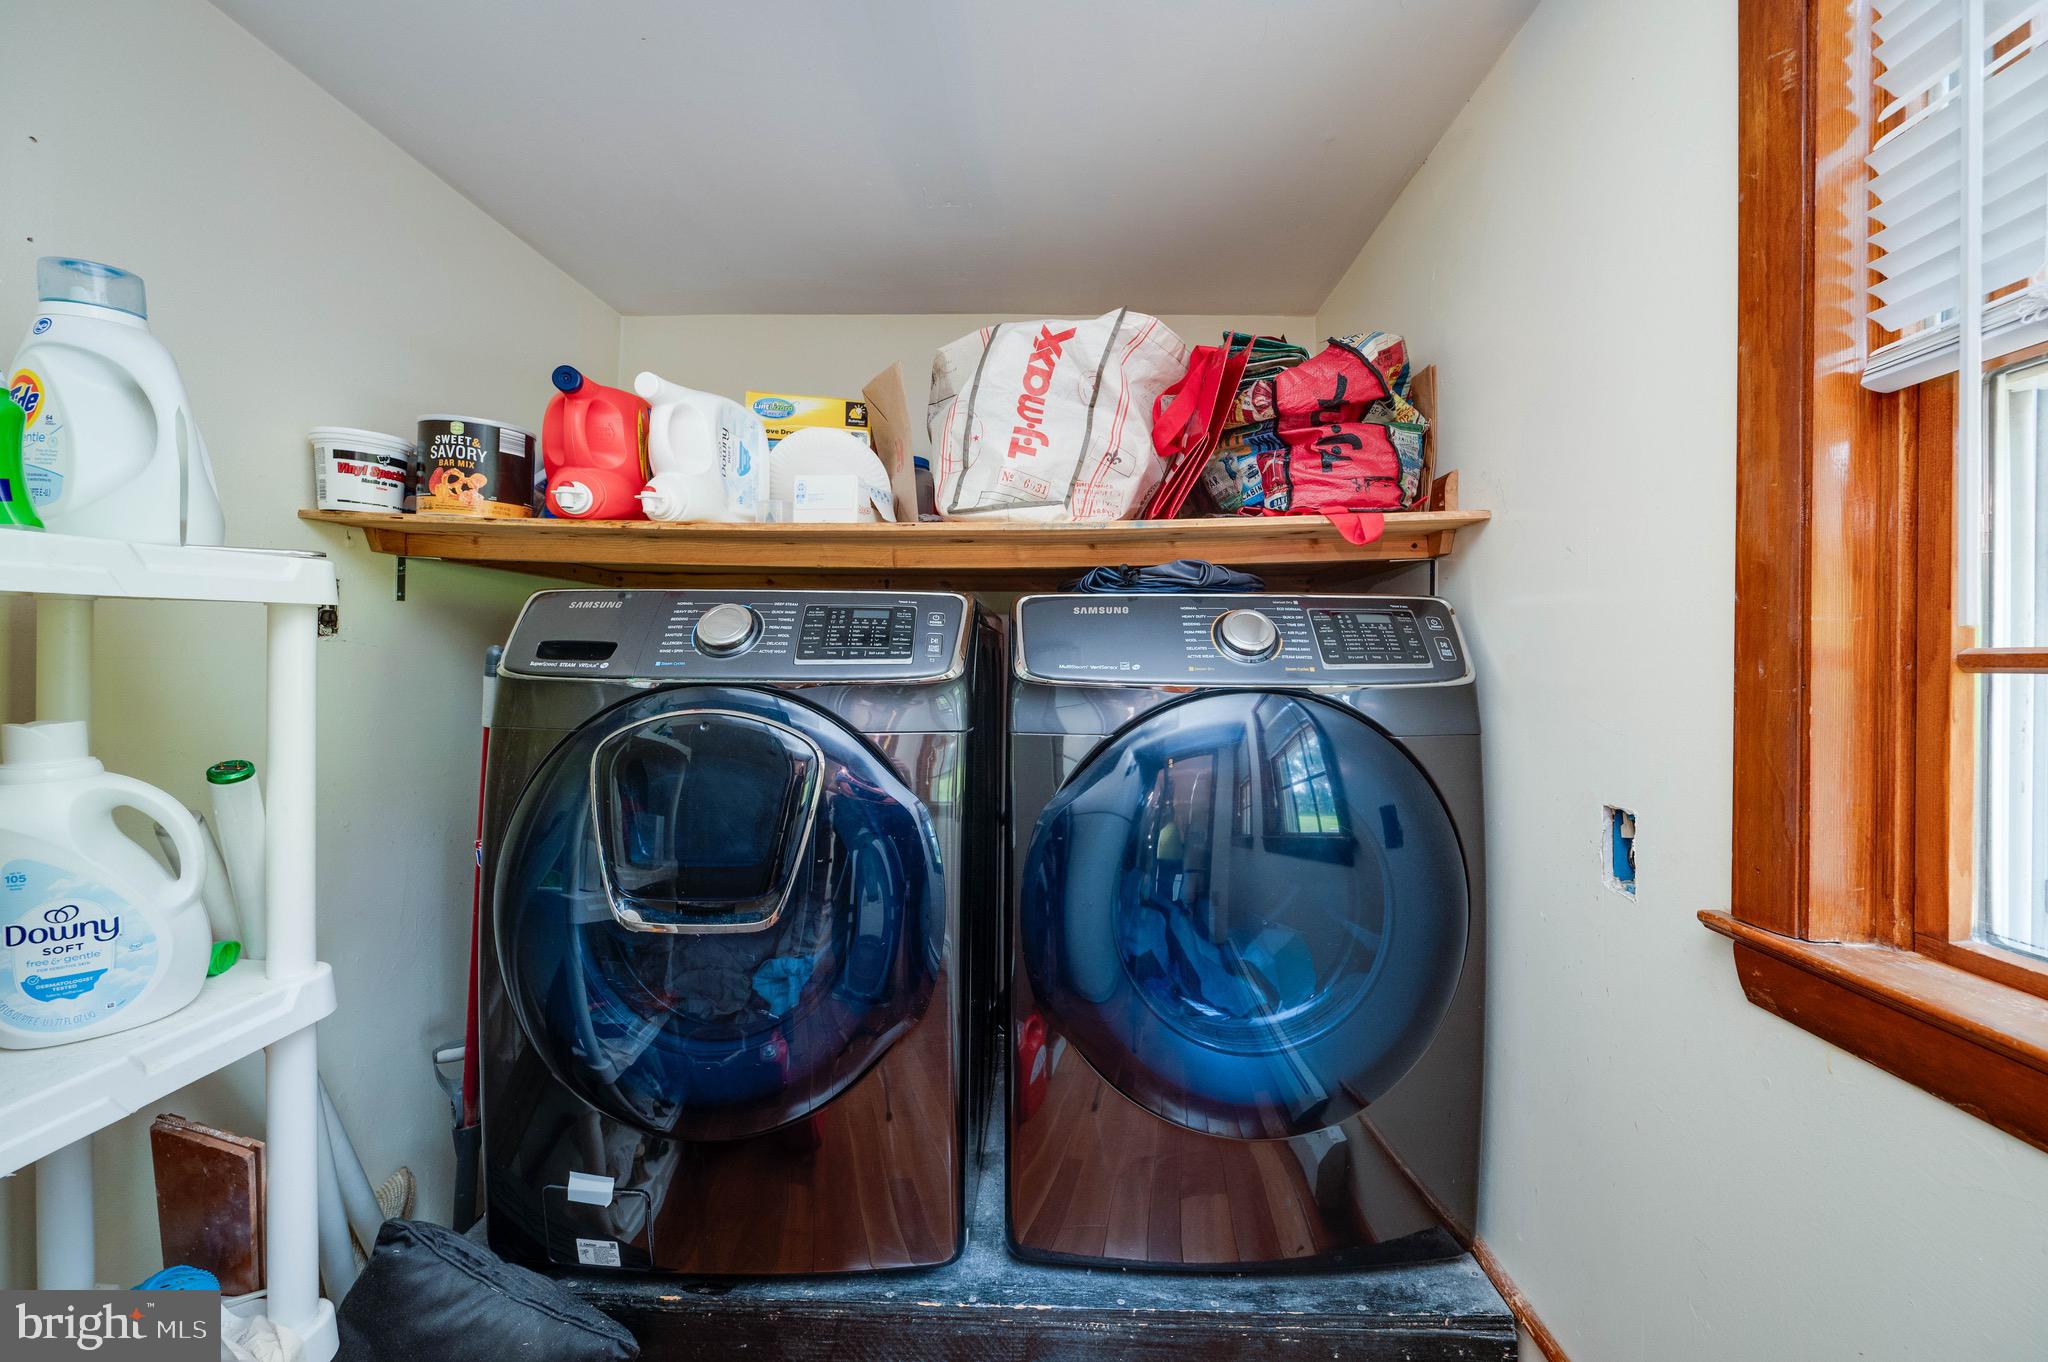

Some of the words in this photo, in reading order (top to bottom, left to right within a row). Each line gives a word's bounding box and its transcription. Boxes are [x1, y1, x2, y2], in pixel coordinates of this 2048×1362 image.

[435, 434, 472, 446] SWEET
[472, 438, 481, 449] &
[430, 444, 488, 463] SAVORY
[337, 461, 368, 477] Vinyl
[438, 459, 455, 467] BAR
[457, 460, 475, 469] MIX
[568, 601, 623, 609] SAMSUNG
[1073, 606, 1129, 615] SAMSUNG
[5, 875, 27, 884] 105
[5, 916, 119, 947] Downy
[42, 942, 84, 956] SOFT
[26, 960, 49, 969] free
[63, 950, 101, 963] gentle
[35, 976, 95, 990] DERMATOLOGIST
[52, 984, 78, 992] TESTED
